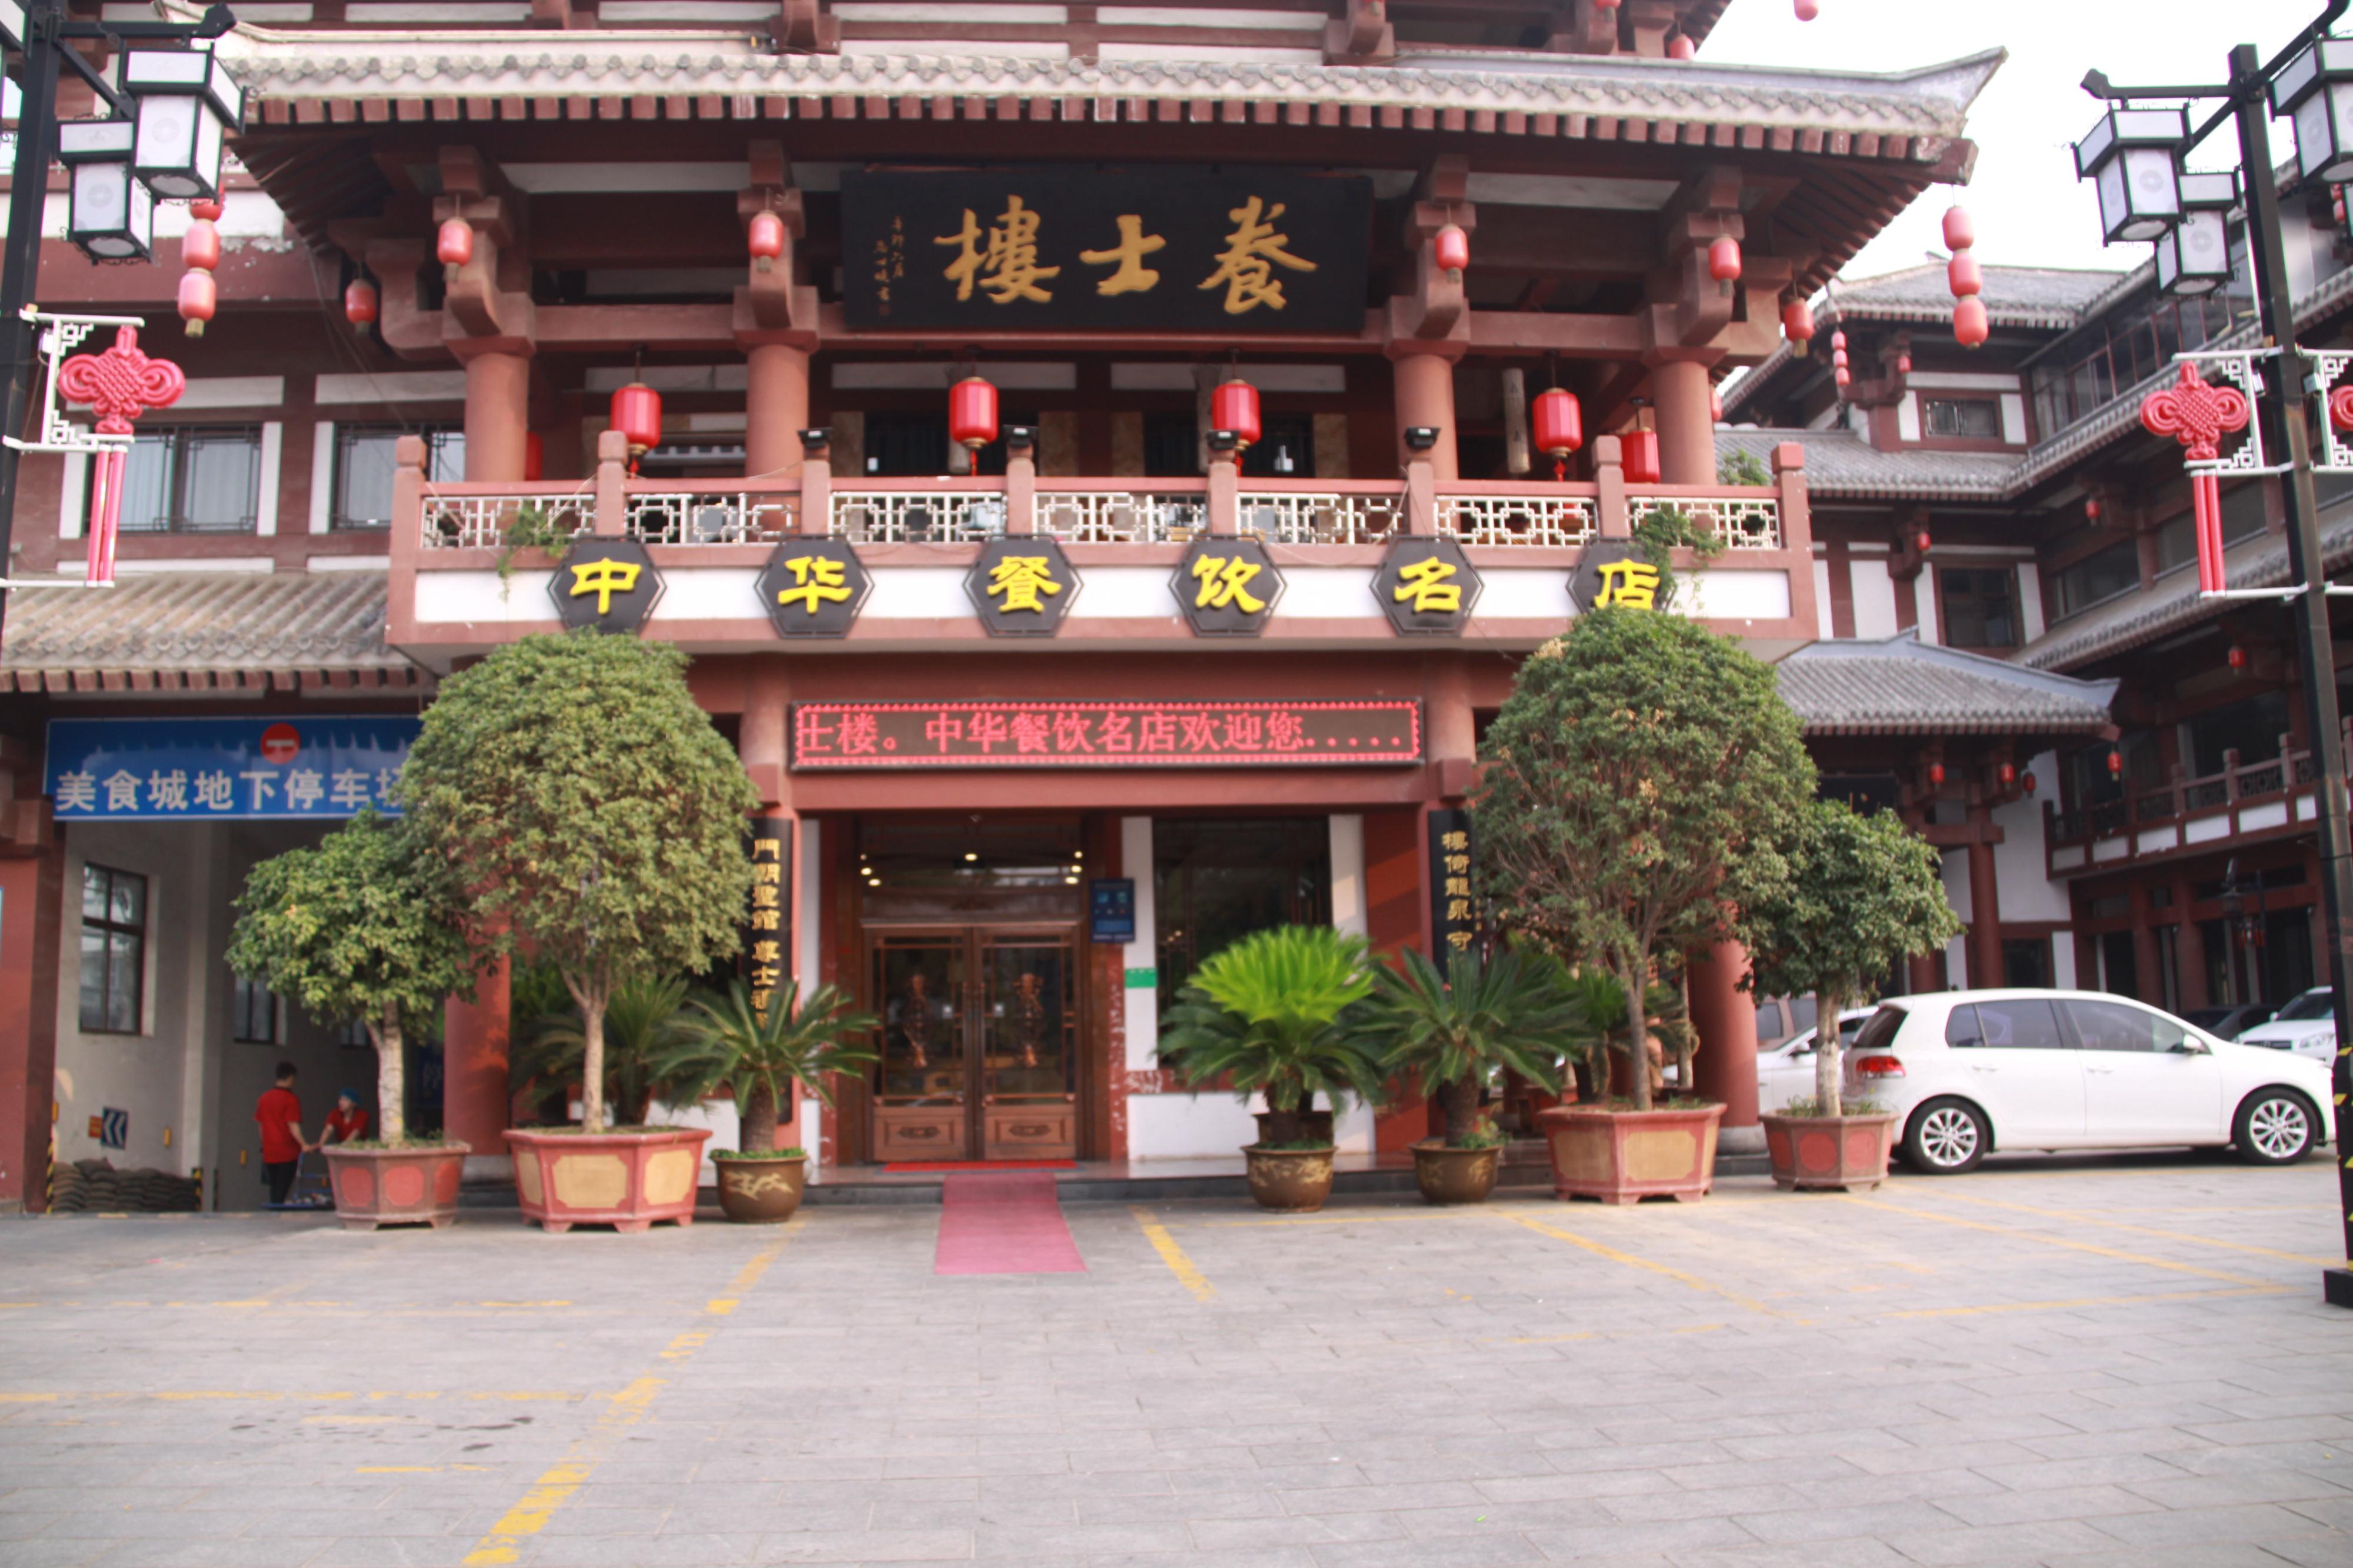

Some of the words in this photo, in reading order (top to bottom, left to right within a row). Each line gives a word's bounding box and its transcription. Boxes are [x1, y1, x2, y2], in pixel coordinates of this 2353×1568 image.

[569, 554, 1661, 614] 中华餐饮名店
